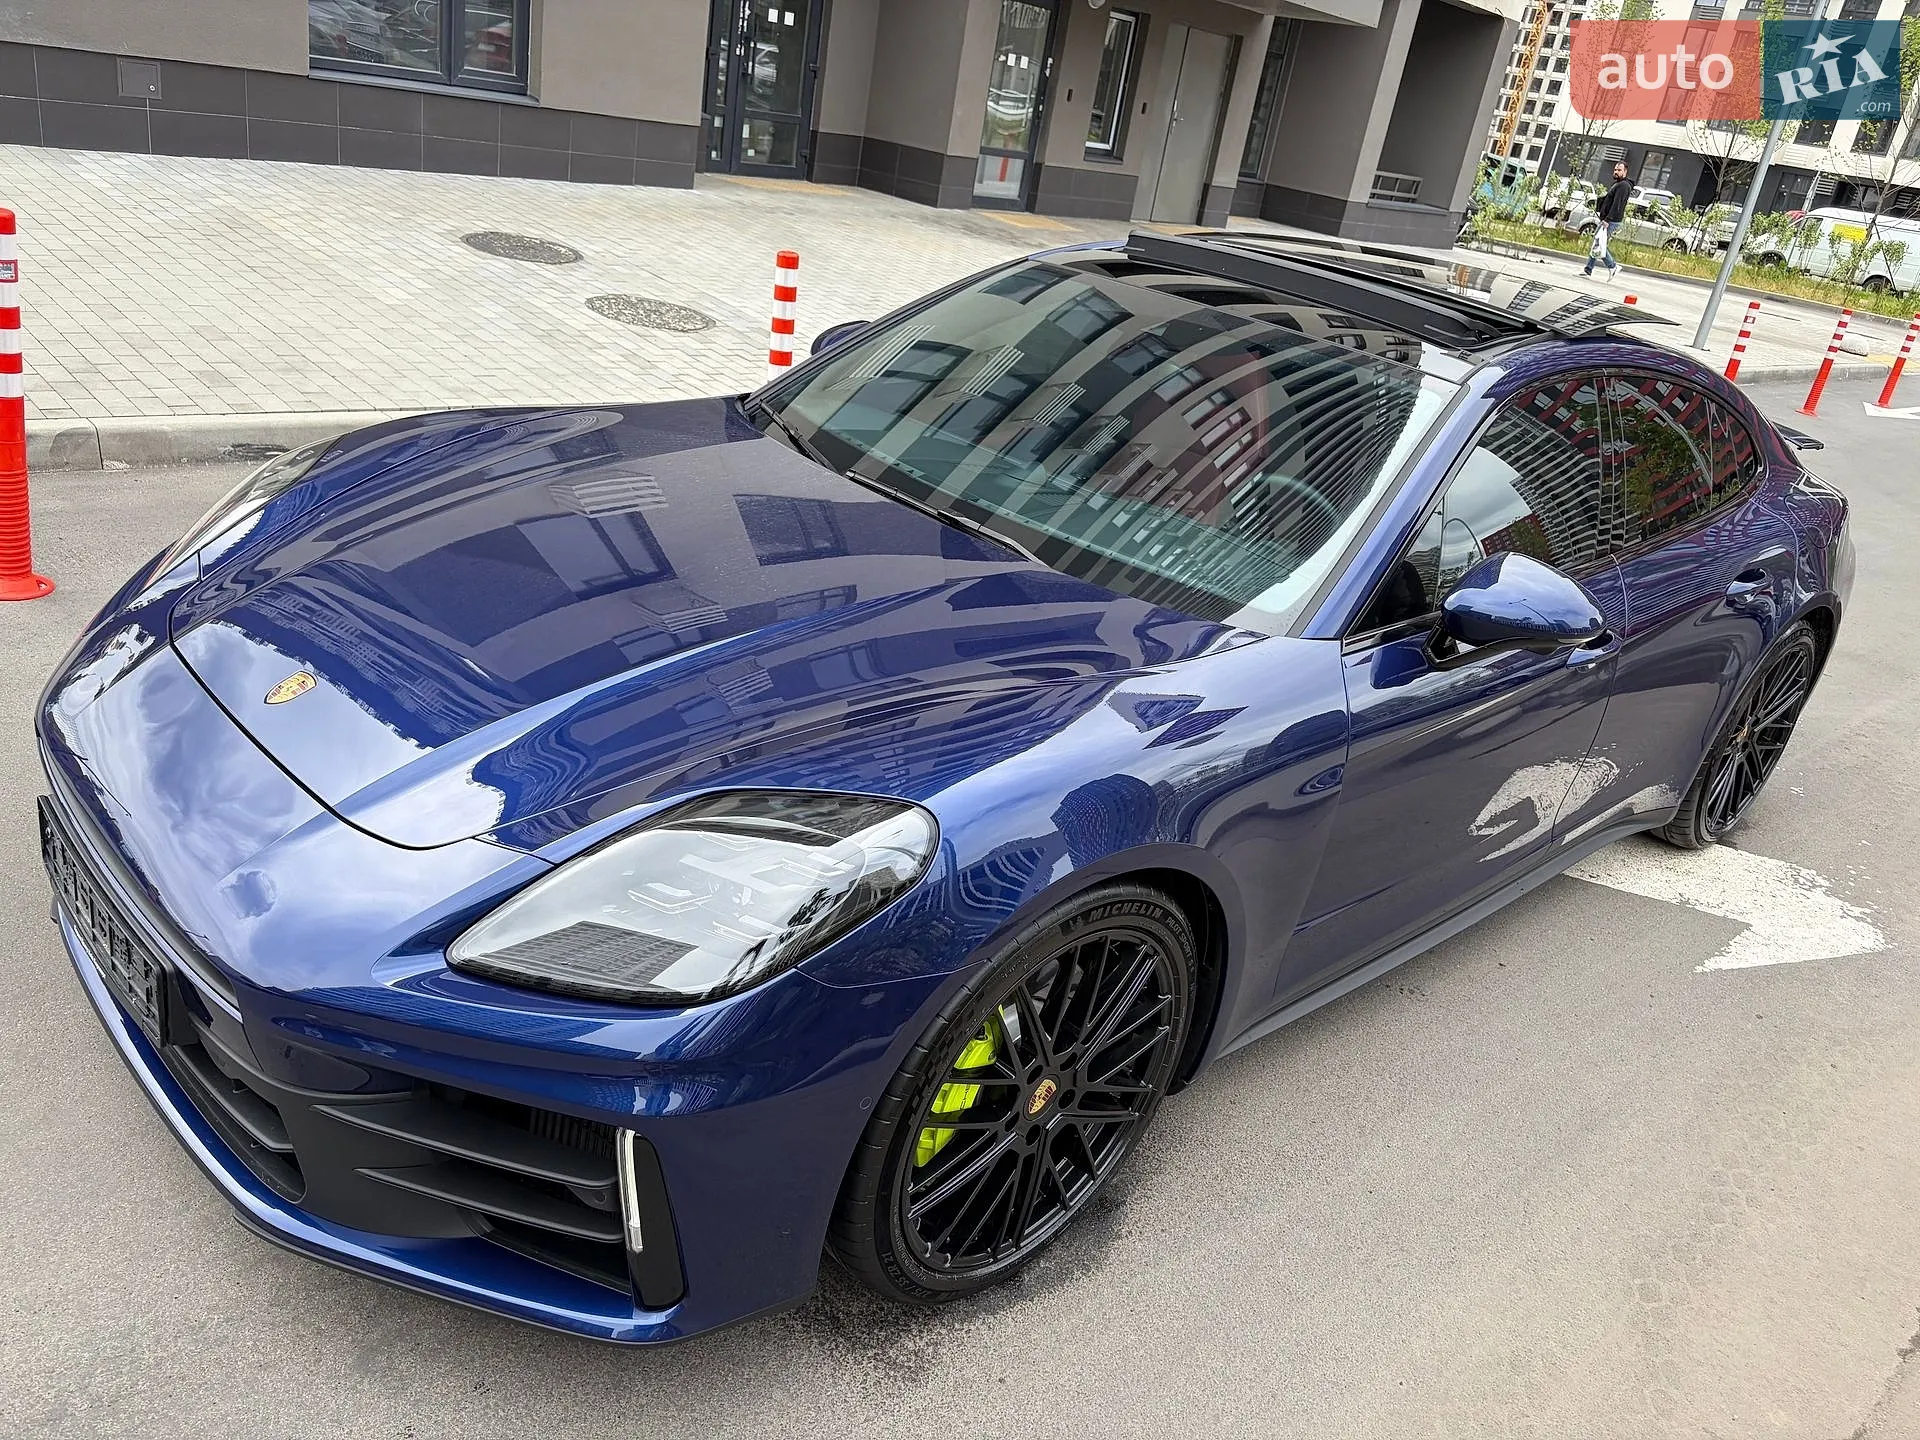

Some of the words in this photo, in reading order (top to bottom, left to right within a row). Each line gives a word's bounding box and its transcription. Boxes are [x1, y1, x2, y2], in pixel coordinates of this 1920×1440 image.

[1088, 902, 1164, 923] MICHELIN
[1165, 916, 1182, 935] PILOT
[1178, 932, 1193, 958] SPORT
